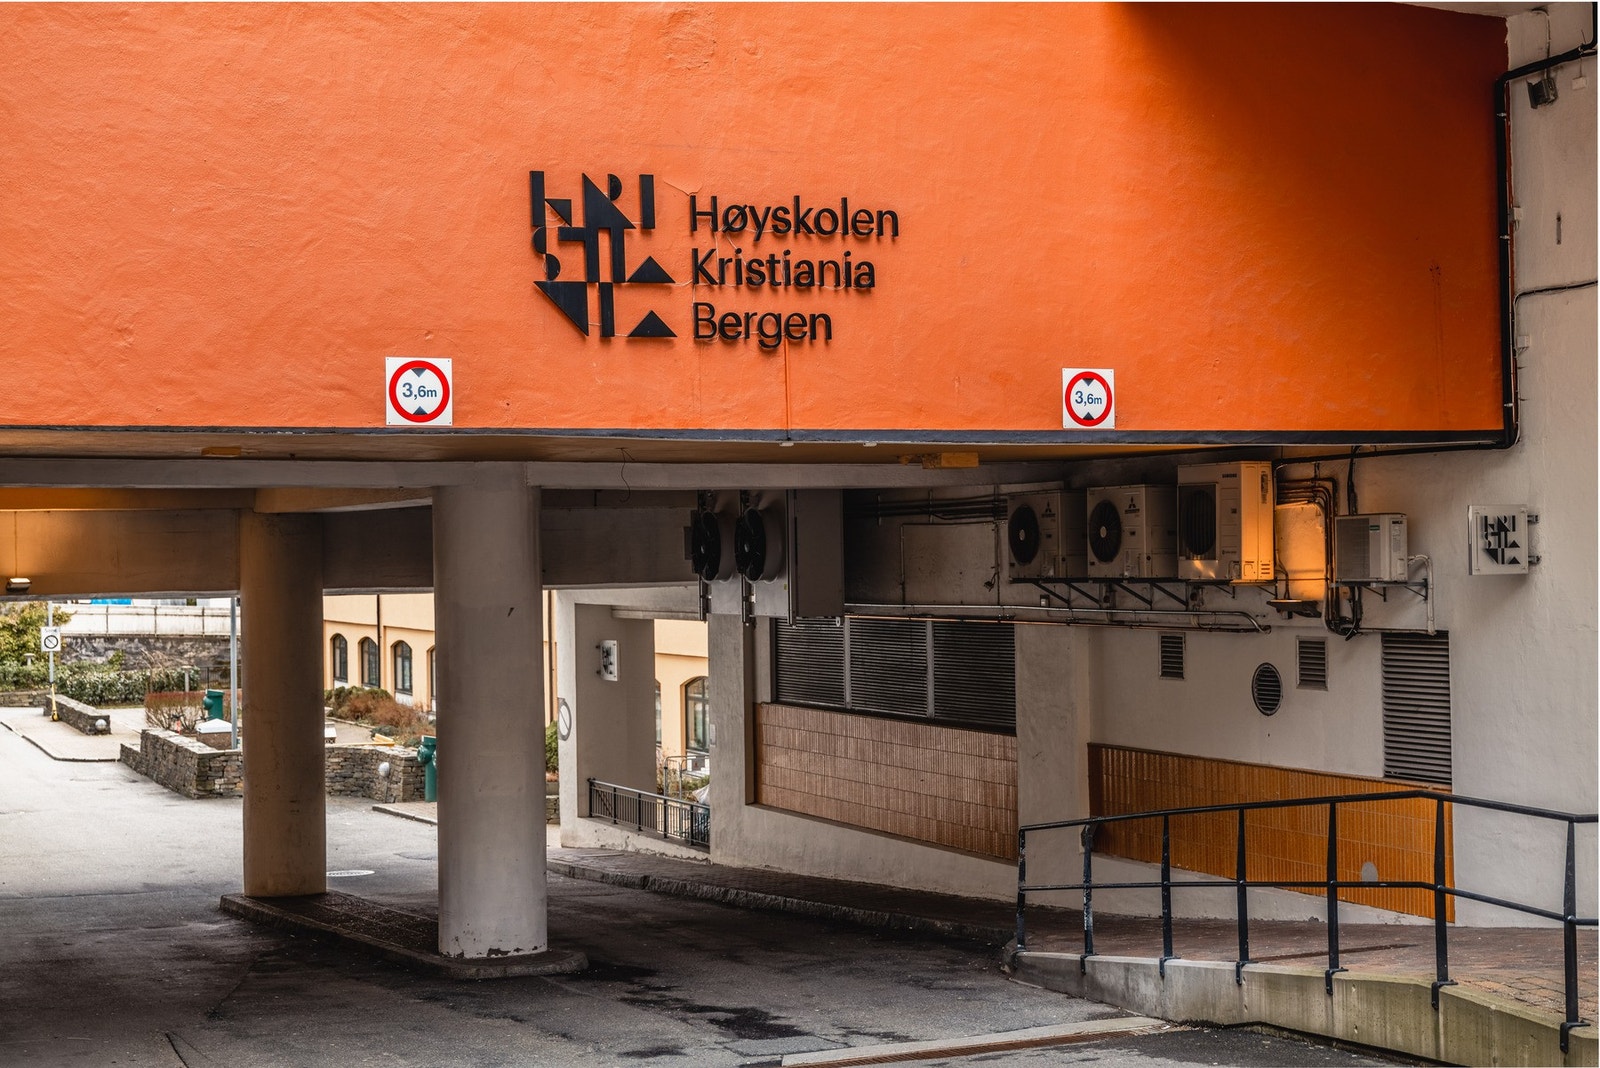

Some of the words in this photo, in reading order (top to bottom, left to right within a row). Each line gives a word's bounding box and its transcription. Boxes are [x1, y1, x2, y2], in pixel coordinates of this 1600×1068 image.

[690, 195, 900, 242] Høyskolen
[691, 247, 876, 289] Kristiania
[693, 302, 833, 349] Bergen
[402, 382, 437, 400] 3,6m
[1075, 390, 1102, 406] 3,6m
